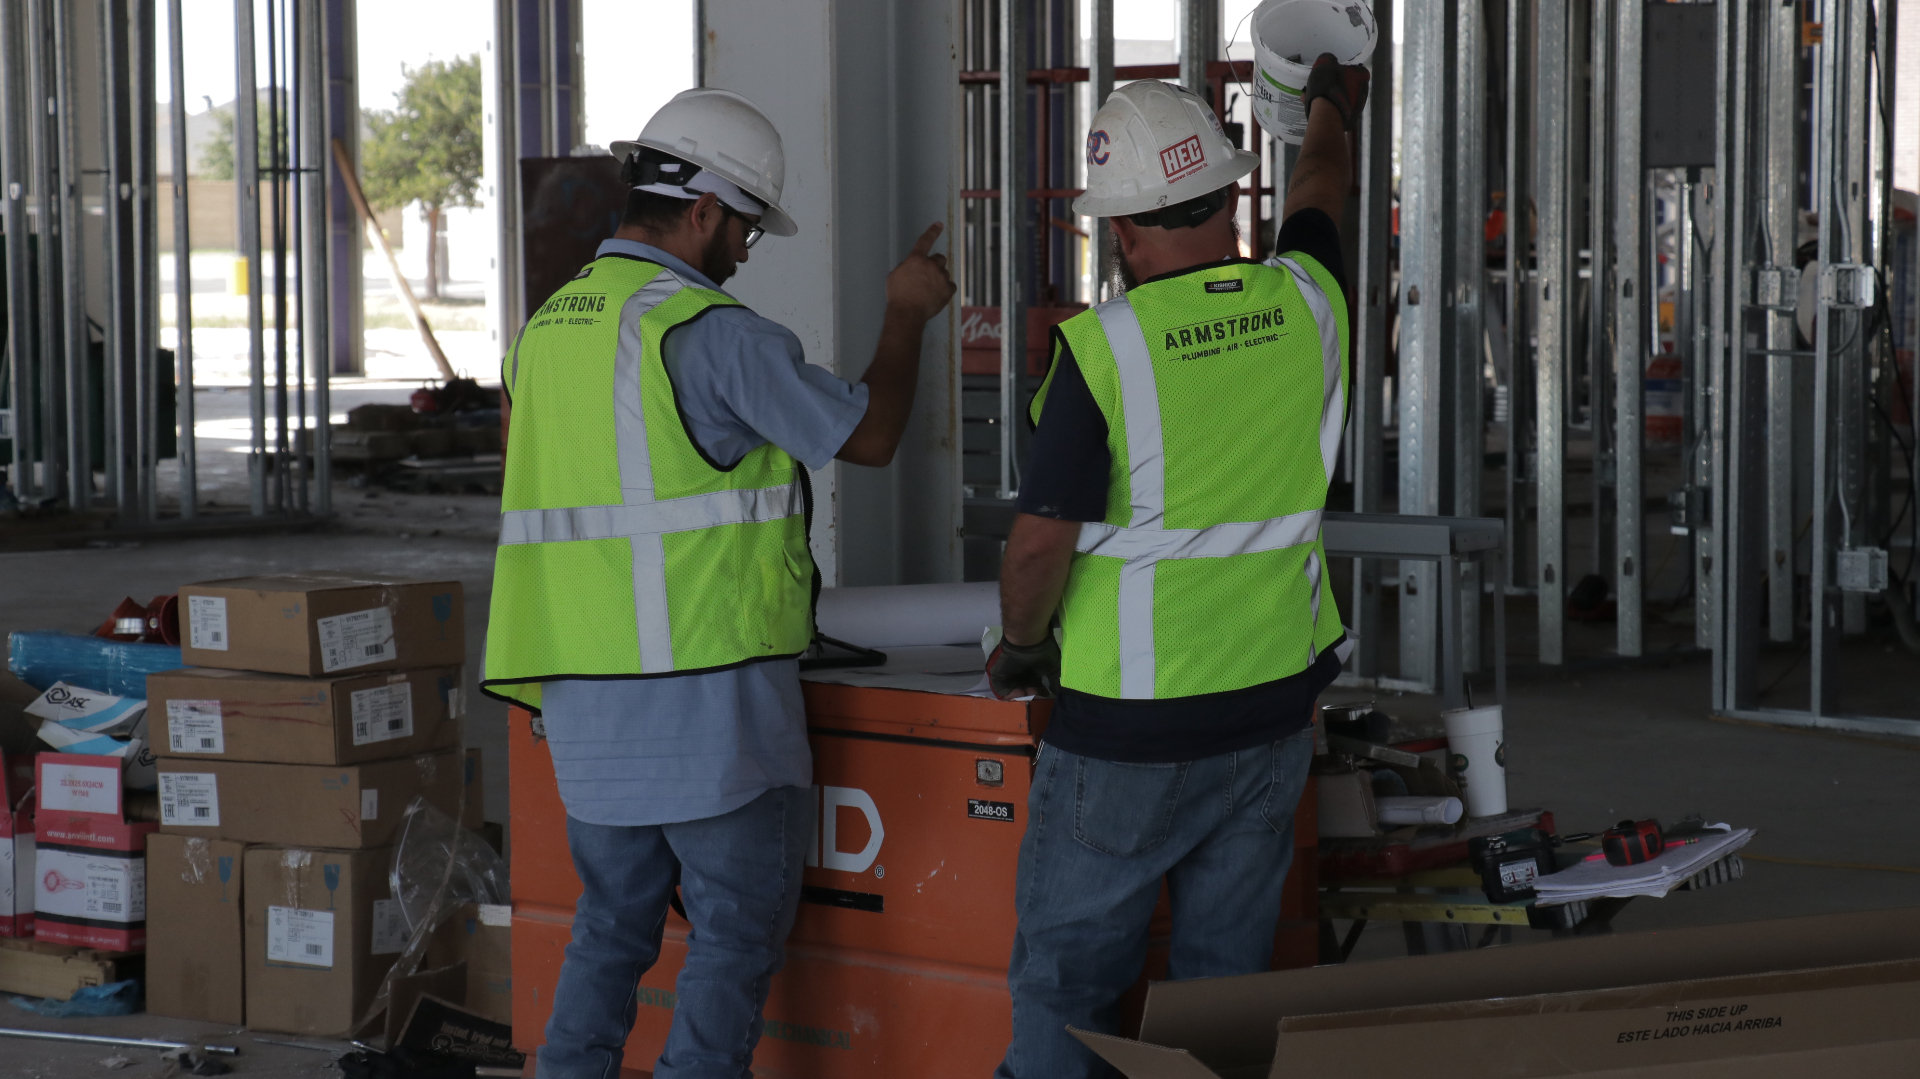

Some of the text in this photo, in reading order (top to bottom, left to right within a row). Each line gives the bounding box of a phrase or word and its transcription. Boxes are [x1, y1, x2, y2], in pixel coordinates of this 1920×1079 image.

[1162, 138, 1203, 176] HEC
[1166, 307, 1285, 351] ARMSTRONG
[1182, 333, 1279, 362] PLUMBING AIR ELECTRIC
[66, 697, 91, 709] ASC
[974, 804, 1008, 817] 2048-OS
[1666, 1004, 1748, 1022] THIS SIDE UP
[1617, 1016, 1782, 1044] ESTE LADO HACIA ARRIBA
